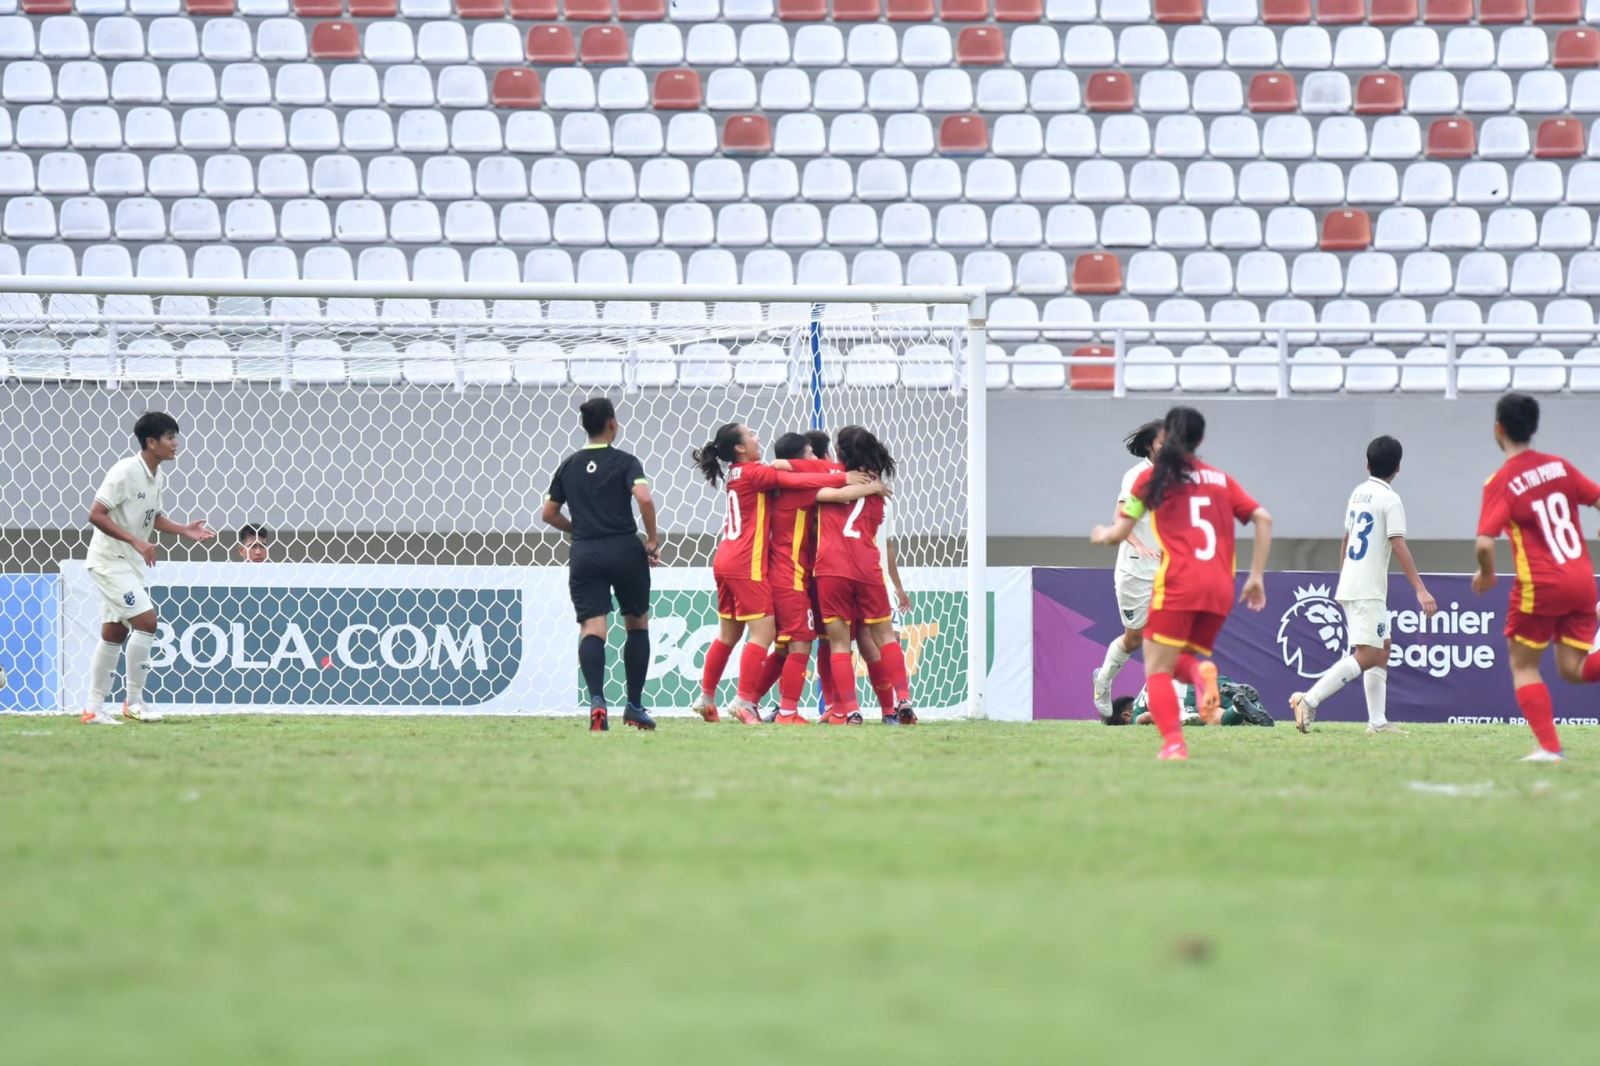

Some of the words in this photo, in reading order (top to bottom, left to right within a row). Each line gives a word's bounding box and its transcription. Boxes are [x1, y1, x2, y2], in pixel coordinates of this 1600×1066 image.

[721, 489, 742, 541] 0
[1190, 496, 1216, 561] 5
[1531, 492, 1582, 565] 18
[1386, 601, 1495, 635] remier
[148, 621, 488, 670] BOLA.COM
[1386, 643, 1495, 678] eague
